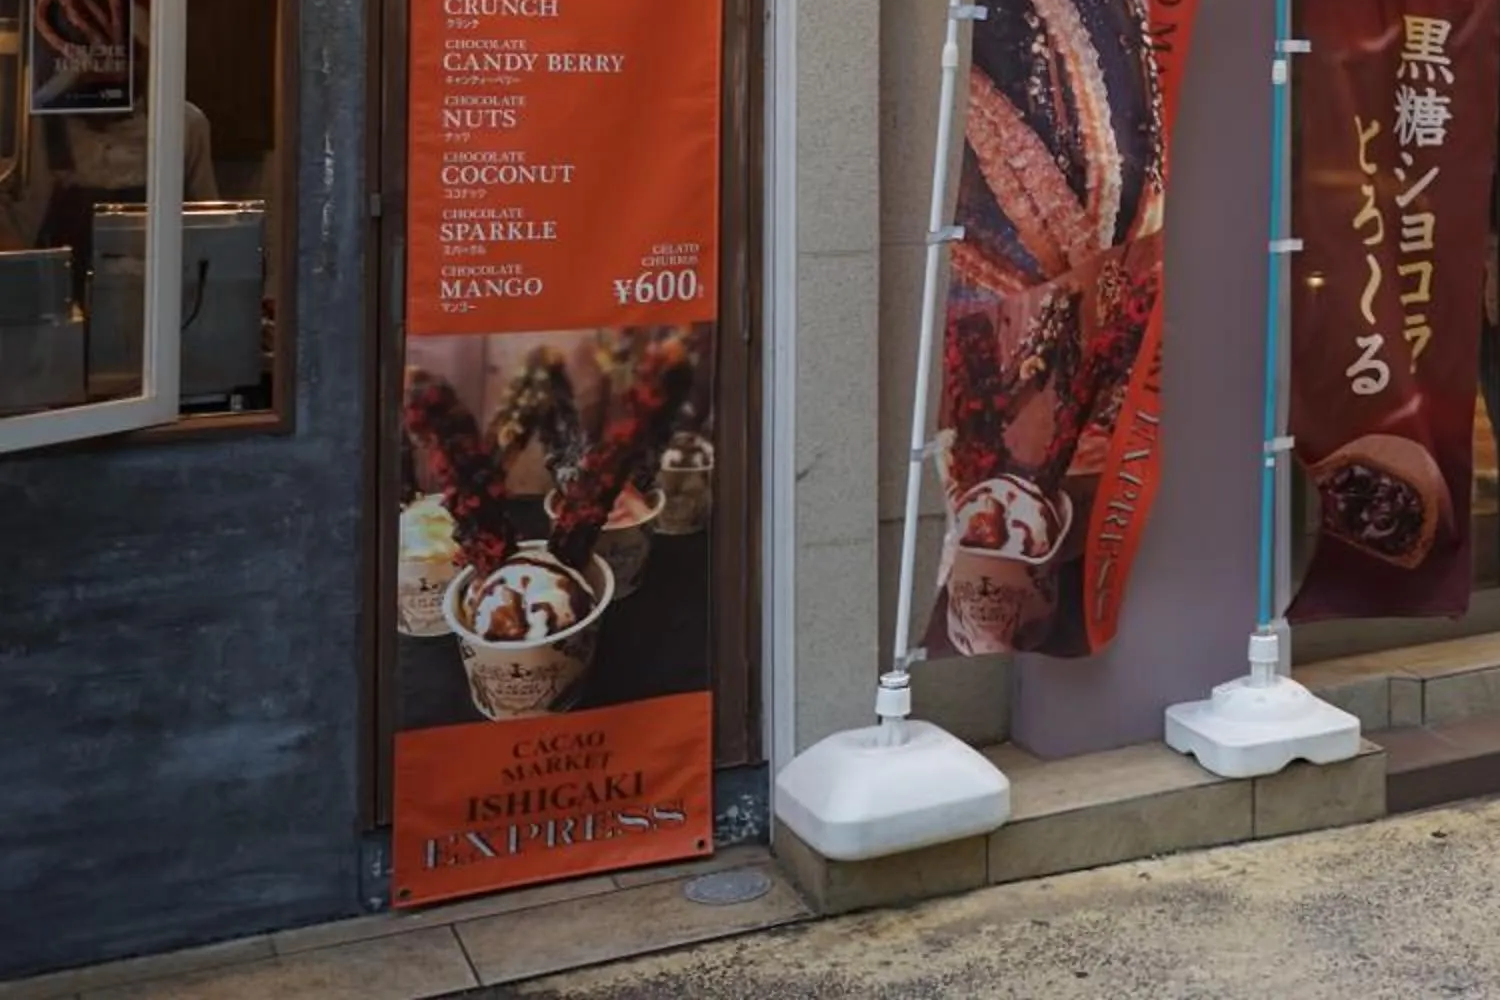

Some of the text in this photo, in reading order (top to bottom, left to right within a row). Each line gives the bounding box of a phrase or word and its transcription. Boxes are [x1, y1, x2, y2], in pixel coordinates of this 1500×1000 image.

[445, 39, 526, 50] CHOCOLATE
[443, 52, 624, 73] CANDY BERRY
[444, 95, 526, 106] CHOCOLATE
[442, 109, 516, 128] NUTS
[443, 151, 526, 163] CHOCOLATE
[441, 165, 575, 184] COCONUT
[1394, 14, 1454, 374] 黒糖ショコラ
[442, 208, 523, 220] CHOCOLATE
[440, 221, 558, 242] SPARKLE
[441, 264, 523, 277] CHOCOLATE
[440, 277, 543, 300] MANGO
[612, 269, 697, 304] ¥600
[512, 731, 606, 759] CACAO
[502, 752, 611, 783] MARKET
[467, 771, 644, 822] ISHIGAKI
[424, 799, 687, 869] EXPRESS
